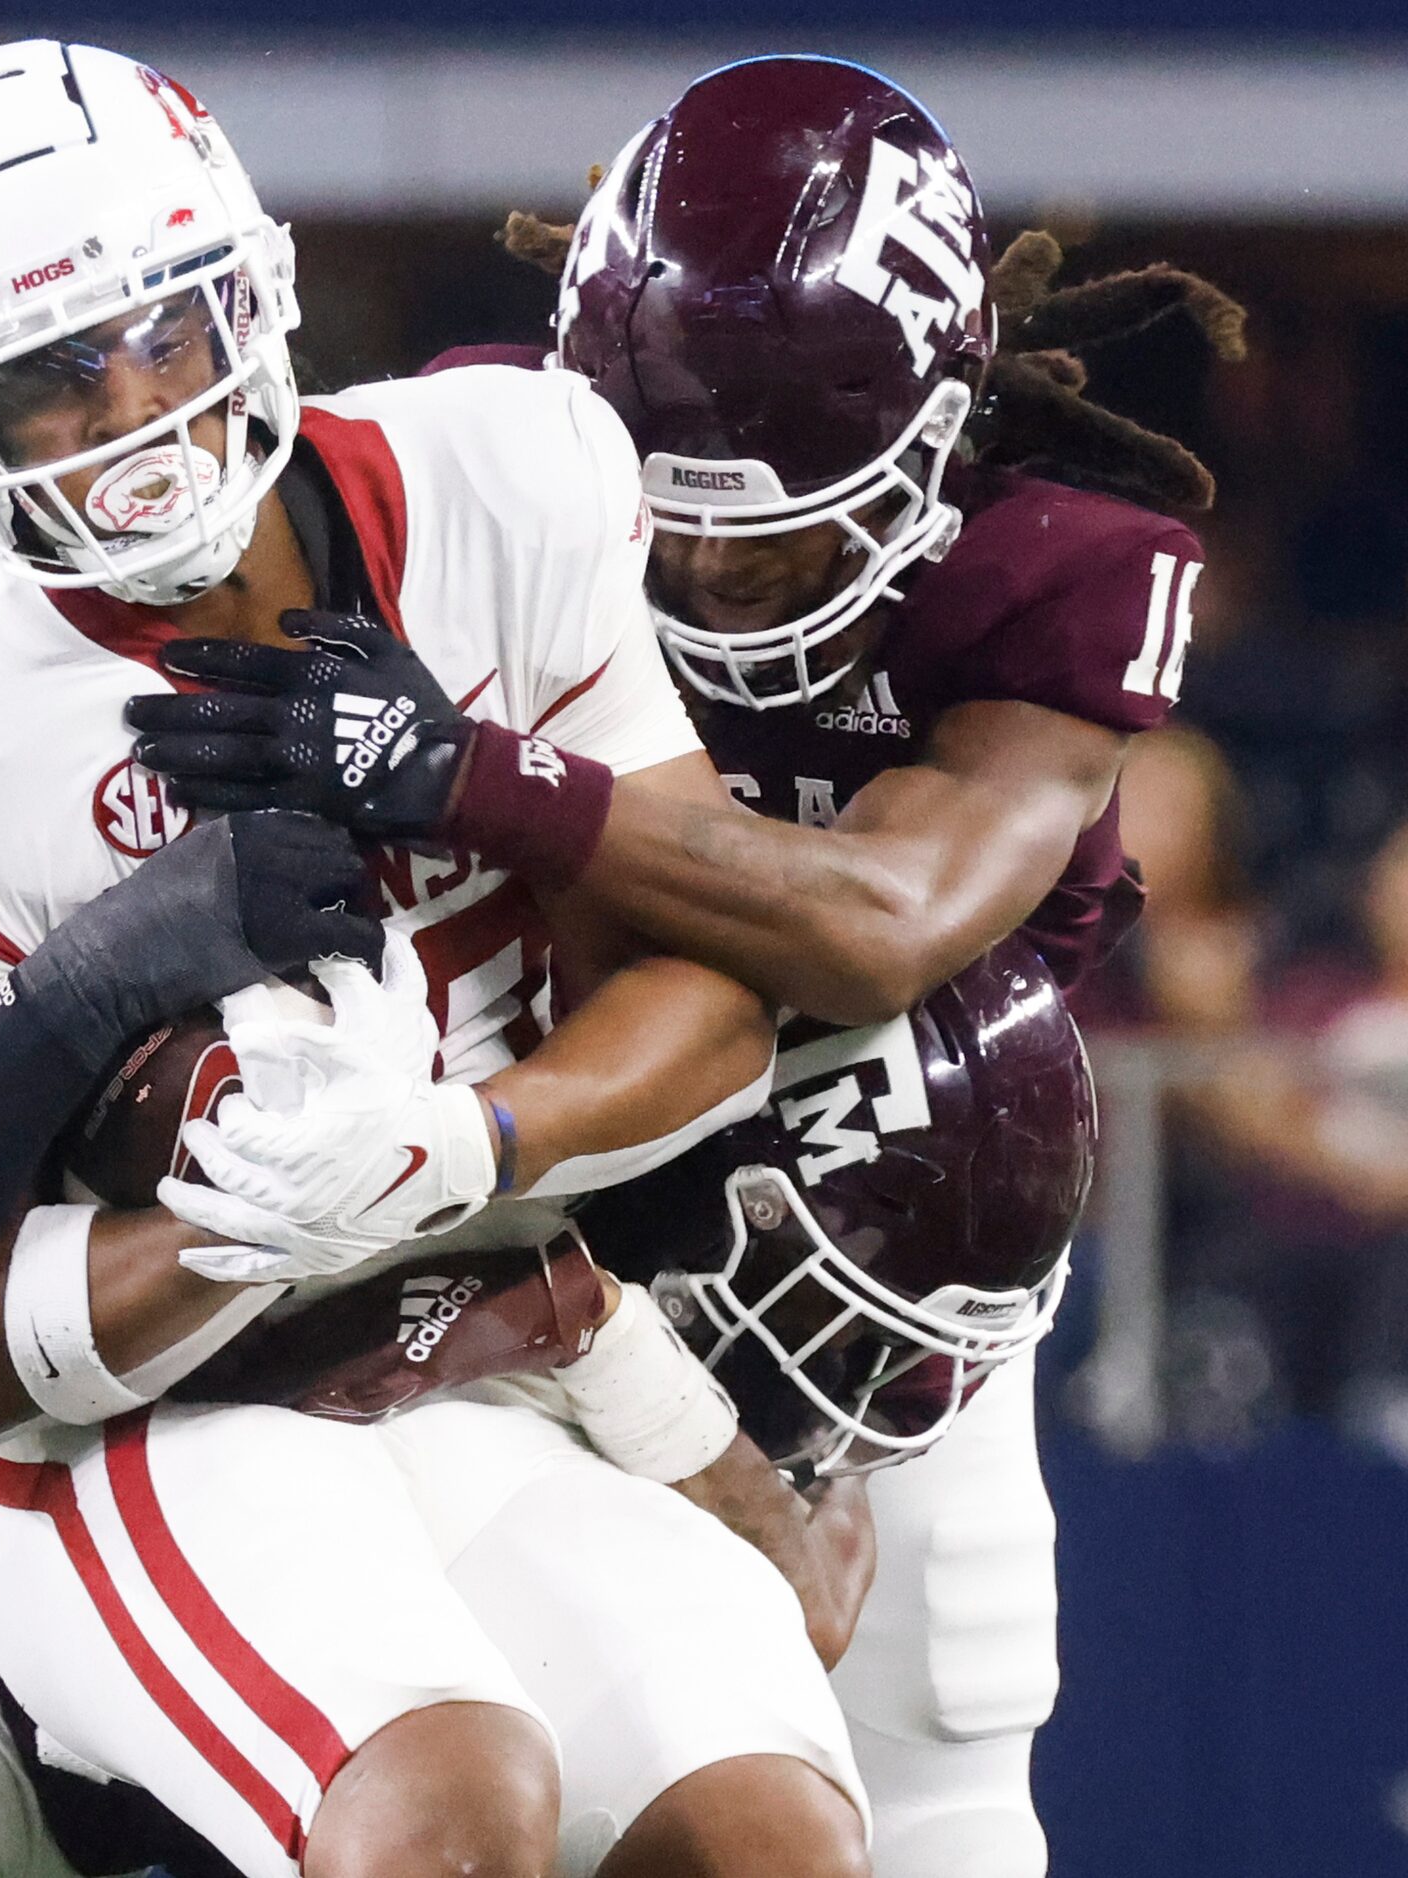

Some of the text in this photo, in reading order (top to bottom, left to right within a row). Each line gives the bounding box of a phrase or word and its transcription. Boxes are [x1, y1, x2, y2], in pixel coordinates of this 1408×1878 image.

[10, 257, 76, 295] HOGS
[230, 264, 252, 417] RARBAC
[671, 466, 747, 491] AGGIES
[342, 695, 417, 788] adidas
[815, 705, 912, 739] adidas
[770, 1011, 932, 1188] TM
[404, 1275, 484, 1363] adidas
